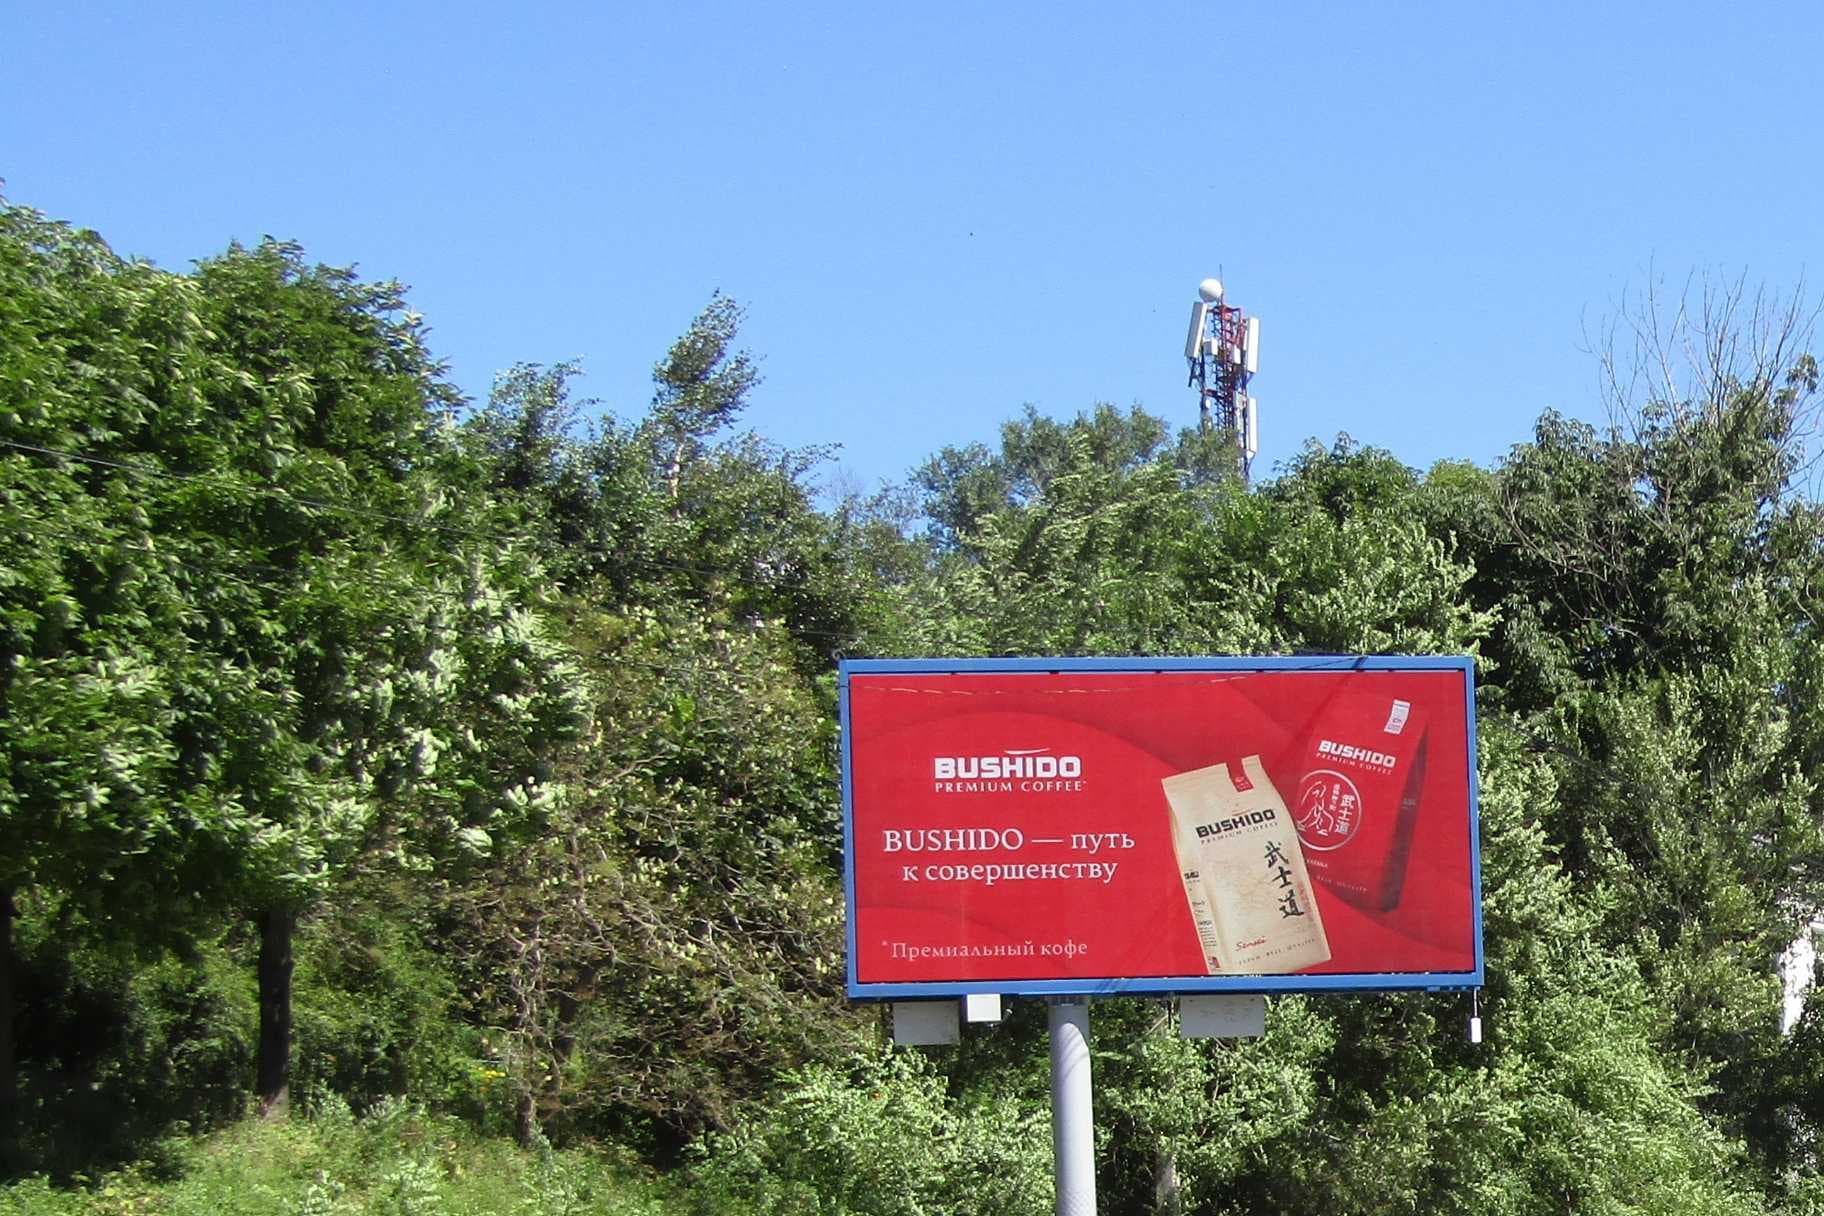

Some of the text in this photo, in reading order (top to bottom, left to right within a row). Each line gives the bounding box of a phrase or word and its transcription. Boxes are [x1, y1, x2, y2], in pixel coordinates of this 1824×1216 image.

[1318, 740, 1397, 768] BUSHIDO
[934, 756, 1082, 779] BUSHIDO
[935, 781, 1013, 793] PREMIUM
[1195, 808, 1276, 838] BUSHIDO
[883, 828, 1024, 852] BUSHIDO
[1071, 833, 1136, 854] путь
[902, 861, 1118, 885] к совершенству
[1040, 939, 1088, 959] кофе
